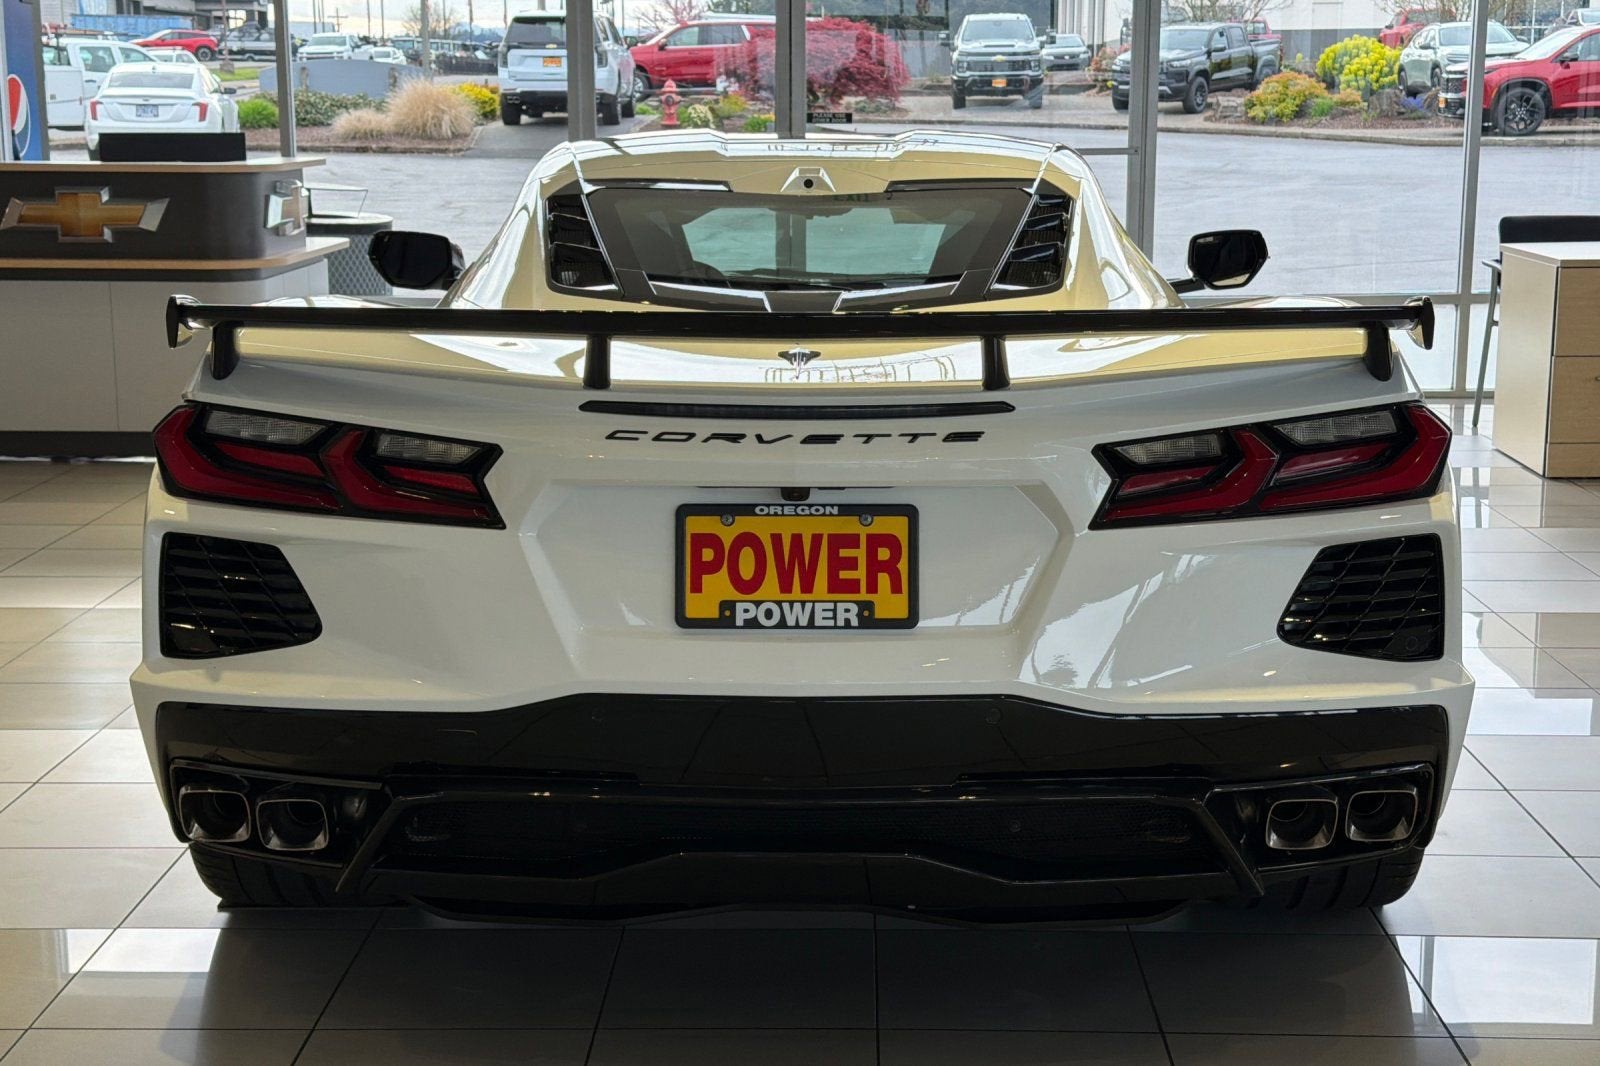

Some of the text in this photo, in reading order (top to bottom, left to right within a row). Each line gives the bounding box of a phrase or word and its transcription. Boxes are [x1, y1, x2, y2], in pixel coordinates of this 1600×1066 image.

[605, 429, 985, 445] CORVETTE
[754, 505, 839, 515] OREGON
[689, 531, 904, 595] POWER
[735, 602, 859, 627] POWER
